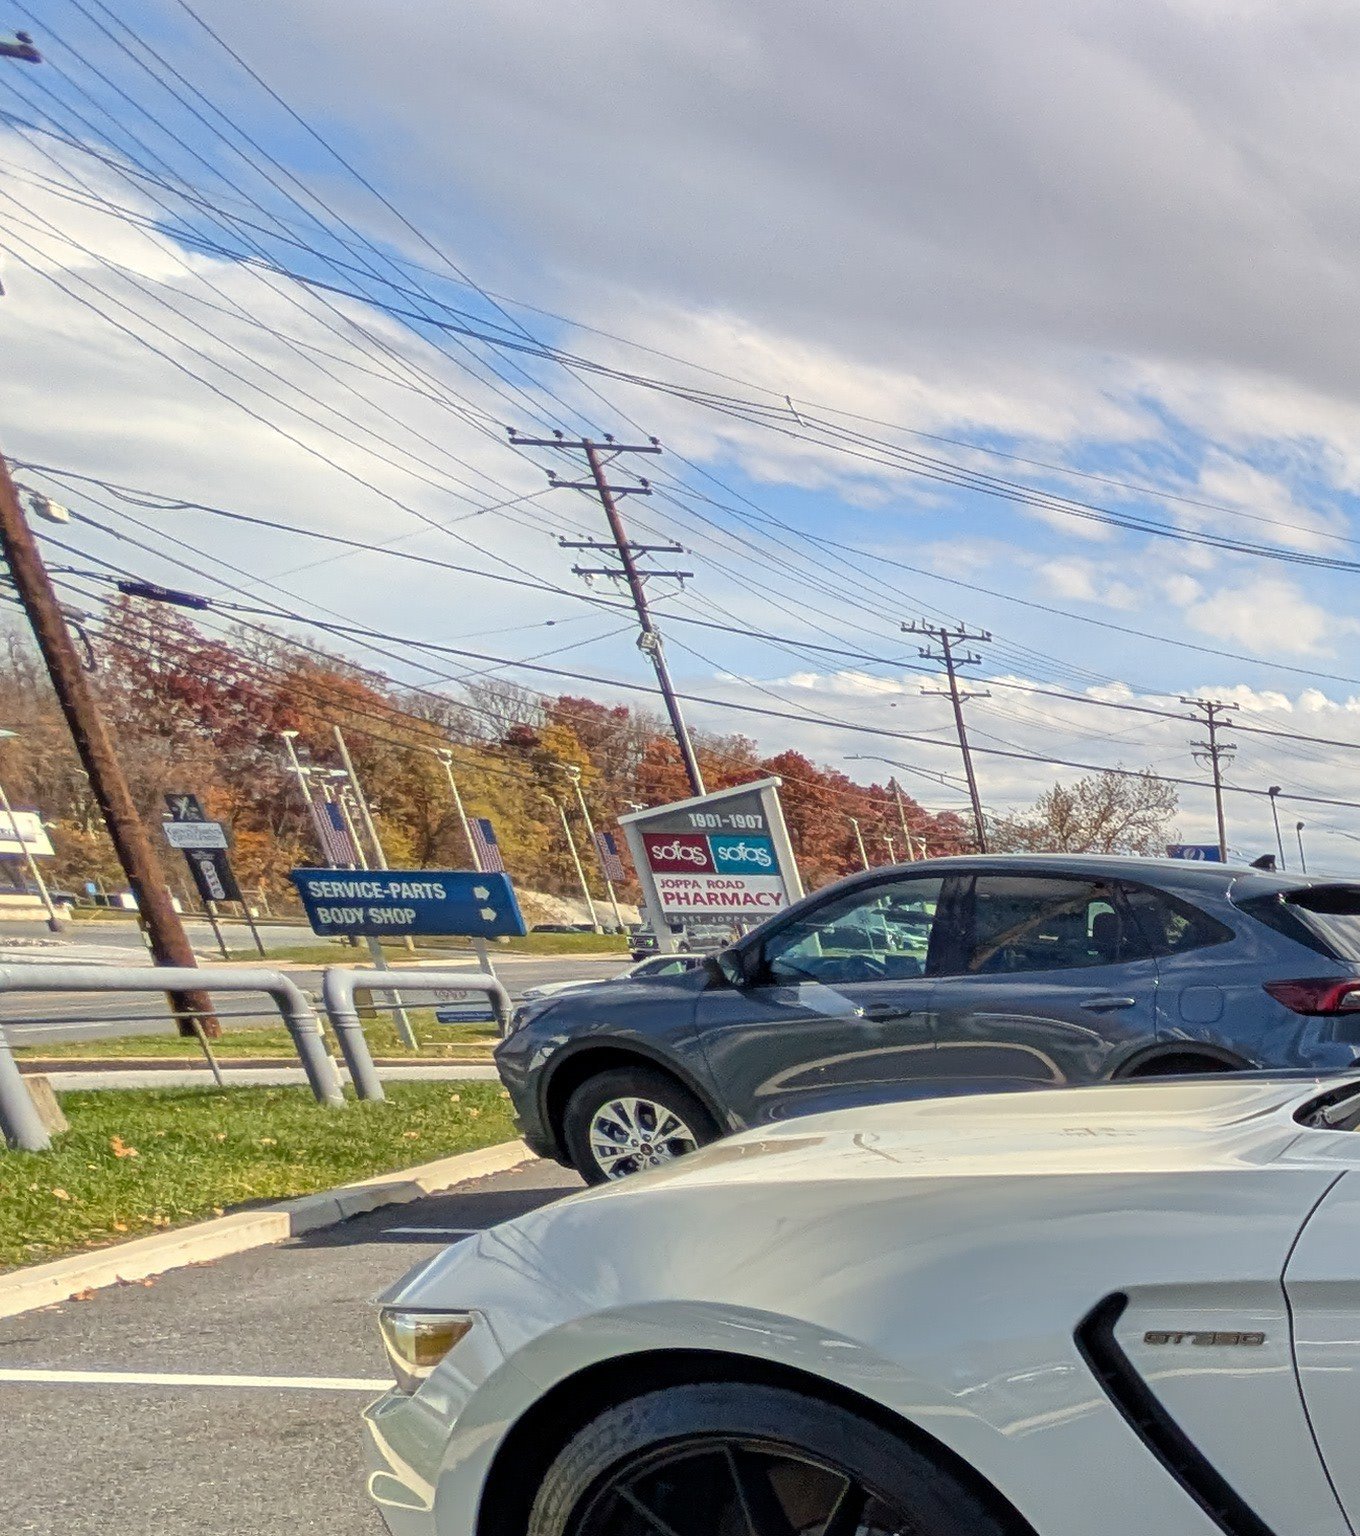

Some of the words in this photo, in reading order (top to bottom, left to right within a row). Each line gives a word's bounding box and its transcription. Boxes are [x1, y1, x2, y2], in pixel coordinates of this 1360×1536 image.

[687, 812, 763, 829] 1901-1907
[651, 840, 708, 866] sofas
[717, 842, 772, 867] sofas
[308, 880, 447, 900] SERVICE-PARTS
[660, 878, 702, 890] JOPPA
[706, 879, 745, 890] ROAD
[662, 891, 783, 907] PHARMACY
[316, 906, 365, 925] BODY
[368, 907, 416, 925] SHOP
